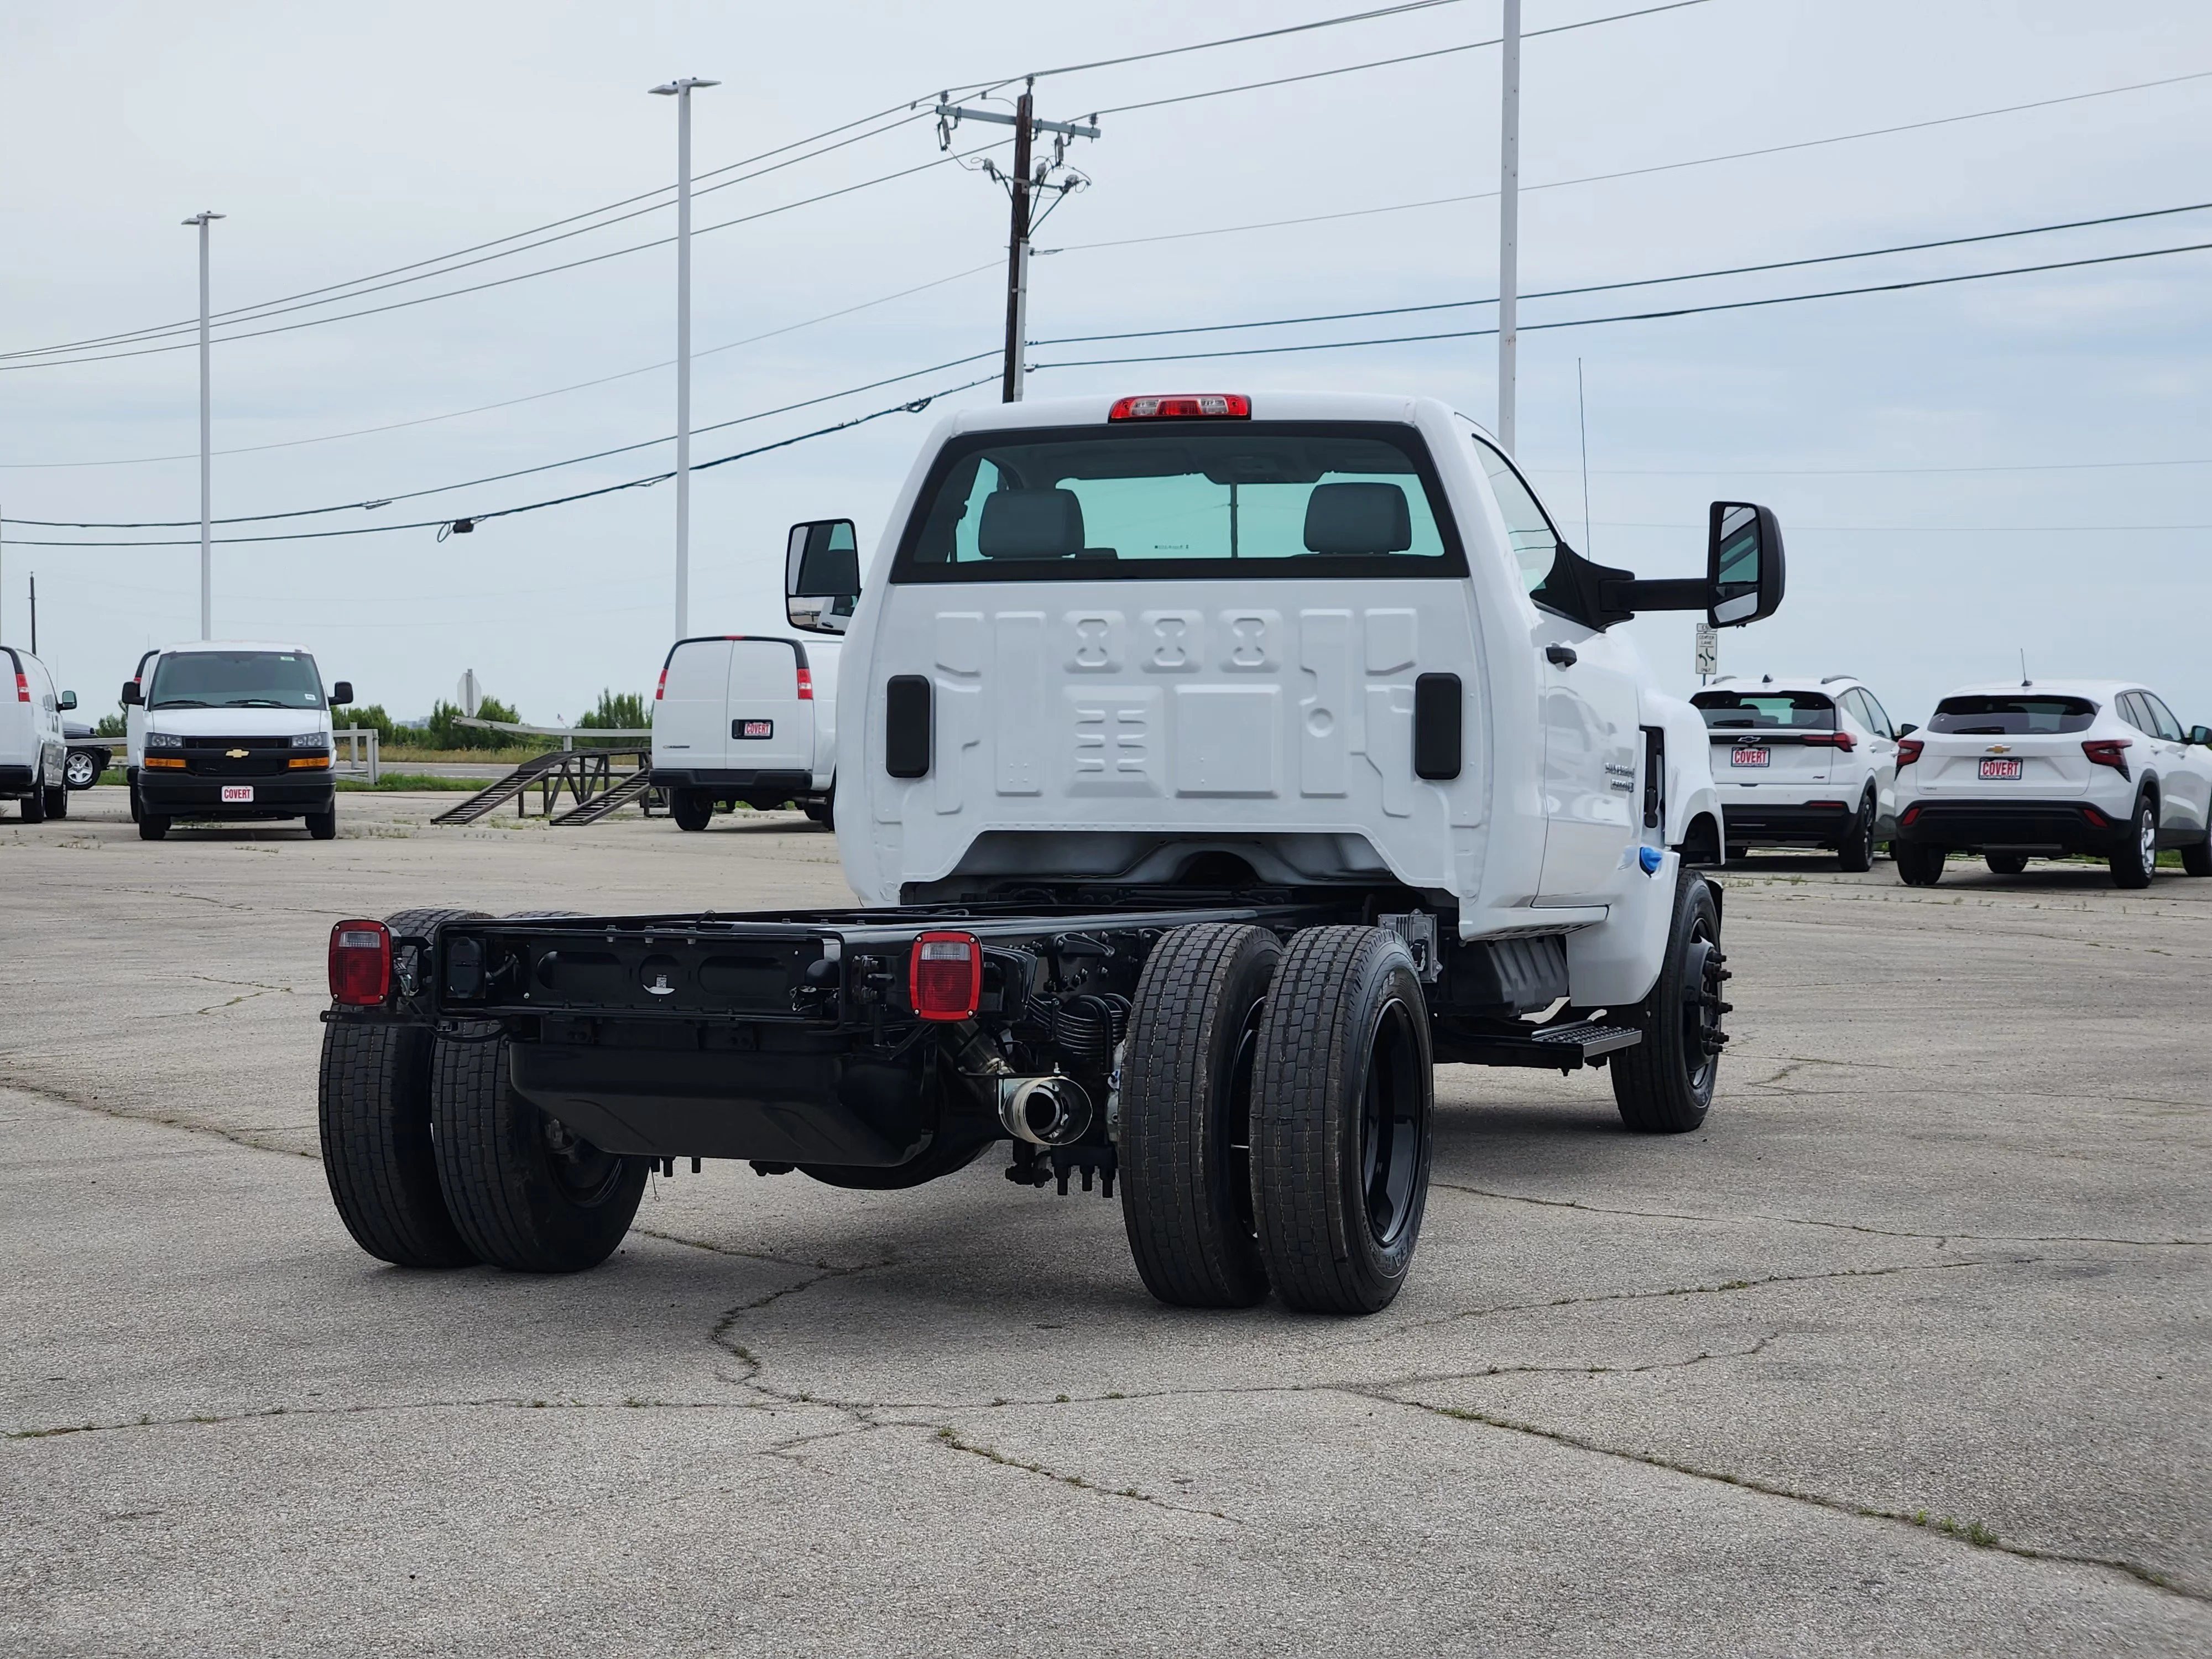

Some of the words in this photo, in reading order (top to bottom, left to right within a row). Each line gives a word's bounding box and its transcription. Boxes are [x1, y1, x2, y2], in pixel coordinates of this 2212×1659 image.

[747, 724, 769, 734] COVERT
[1735, 750, 1767, 763] COVERT
[1983, 761, 2019, 775] COVERT
[224, 789, 251, 799] COVERT
